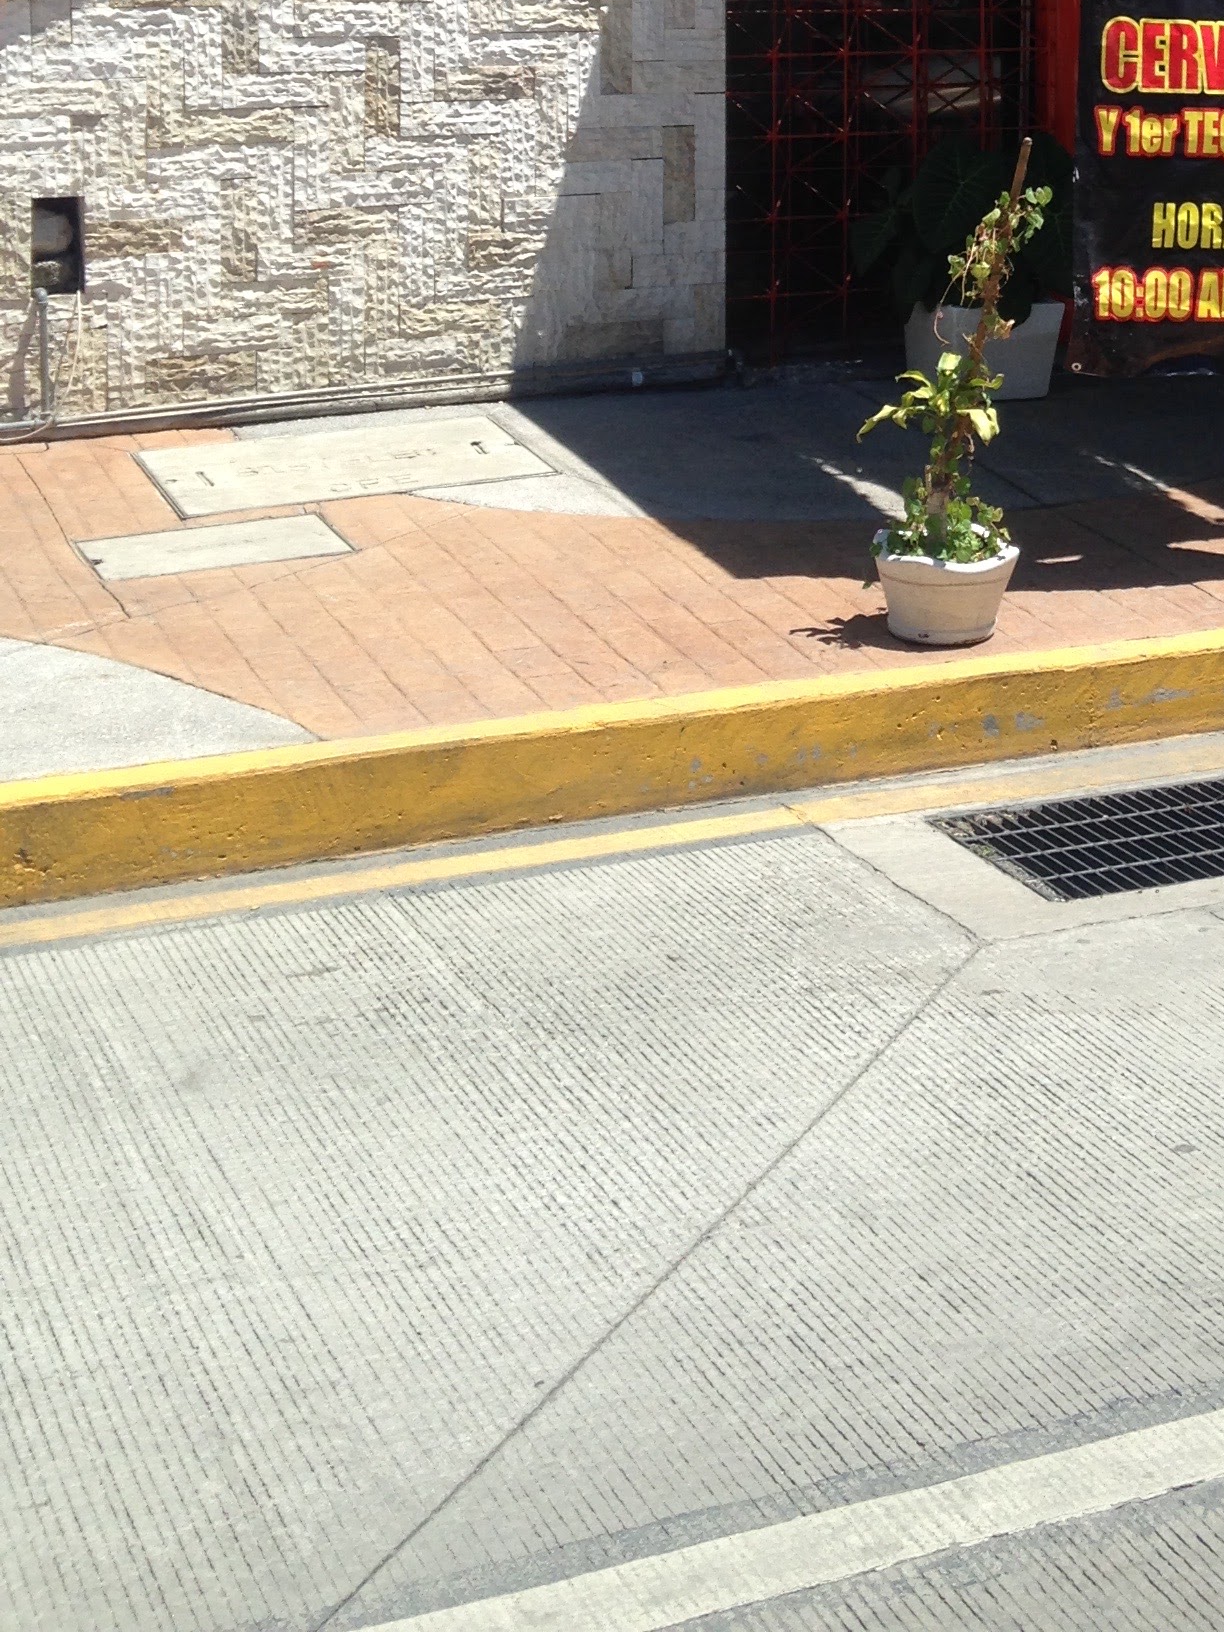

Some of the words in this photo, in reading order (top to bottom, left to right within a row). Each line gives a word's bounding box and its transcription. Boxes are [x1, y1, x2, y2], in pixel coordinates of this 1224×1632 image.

[1094, 105, 1119, 156] Y
[1122, 106, 1179, 157] 1er
[1091, 265, 1195, 322] 10:00
